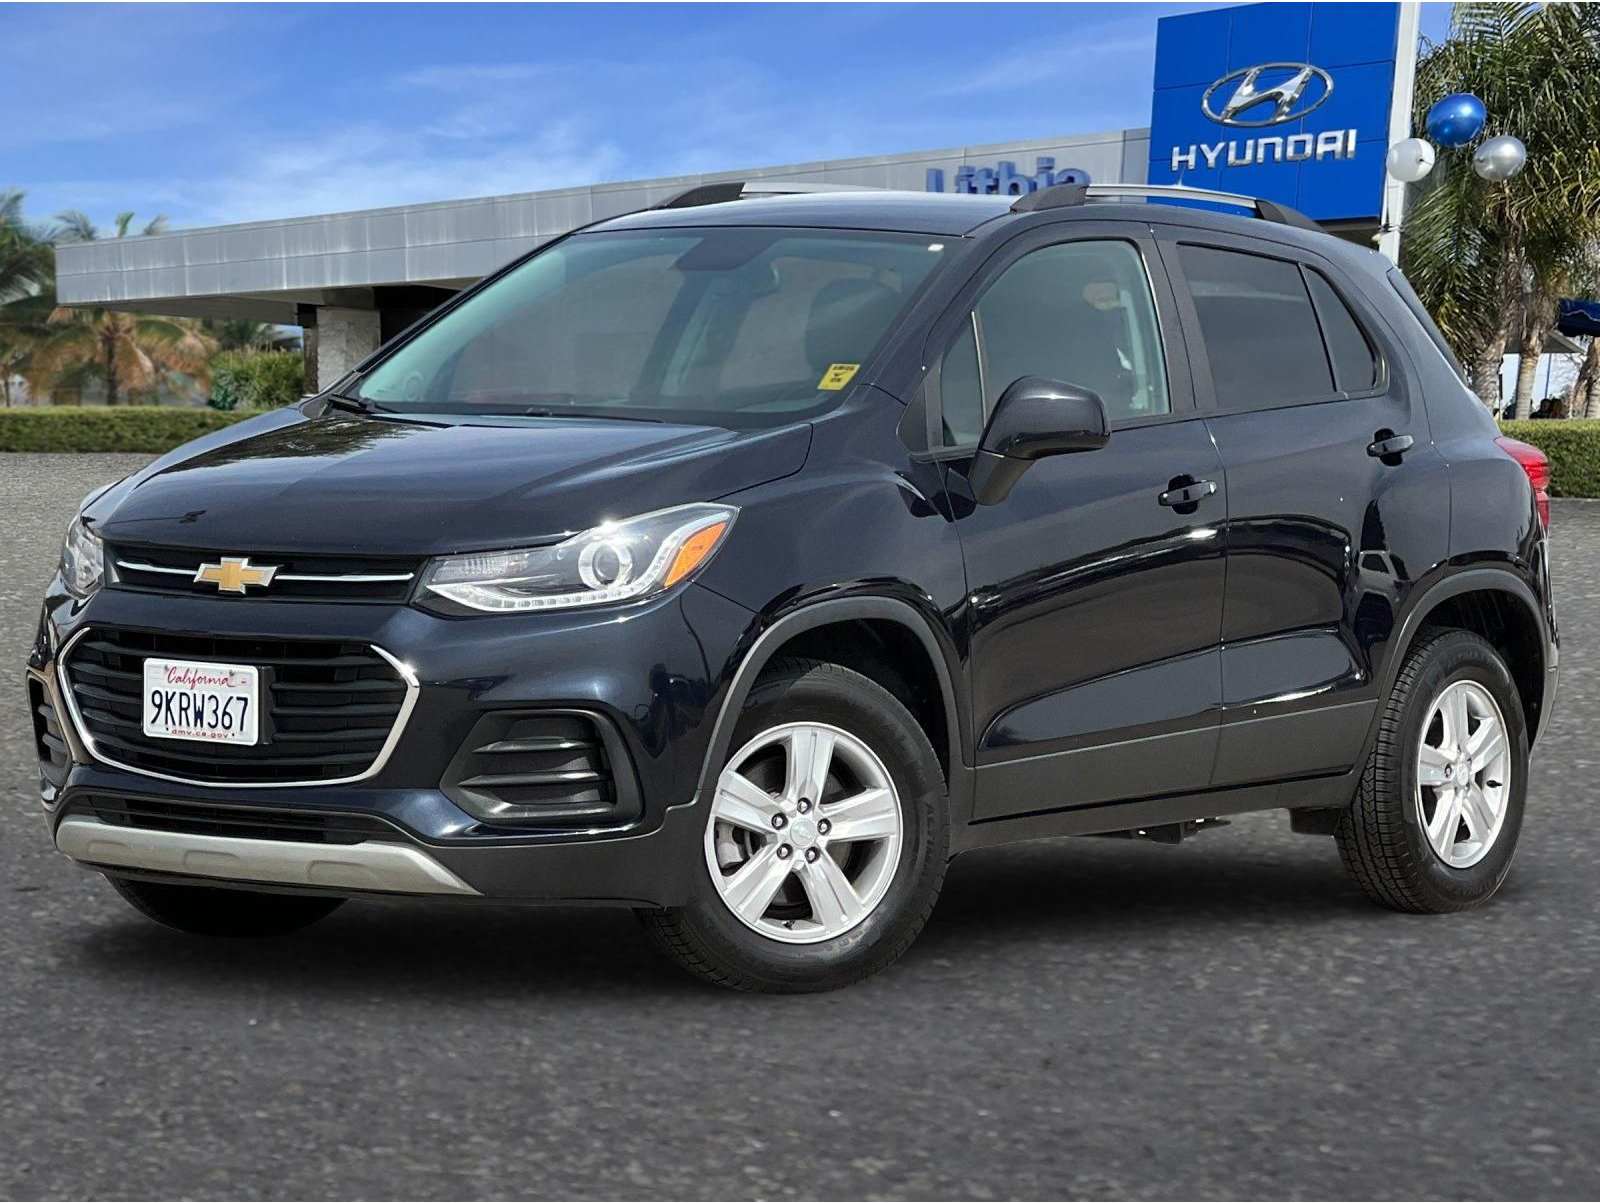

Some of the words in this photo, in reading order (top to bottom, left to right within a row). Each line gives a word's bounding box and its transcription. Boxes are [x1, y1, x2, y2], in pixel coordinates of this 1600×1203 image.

[1170, 128, 1358, 172] HYUNDAI
[167, 666, 236, 690] California
[150, 689, 249, 732] 9KRW367
[171, 729, 229, 739] dmv.ca.gov
